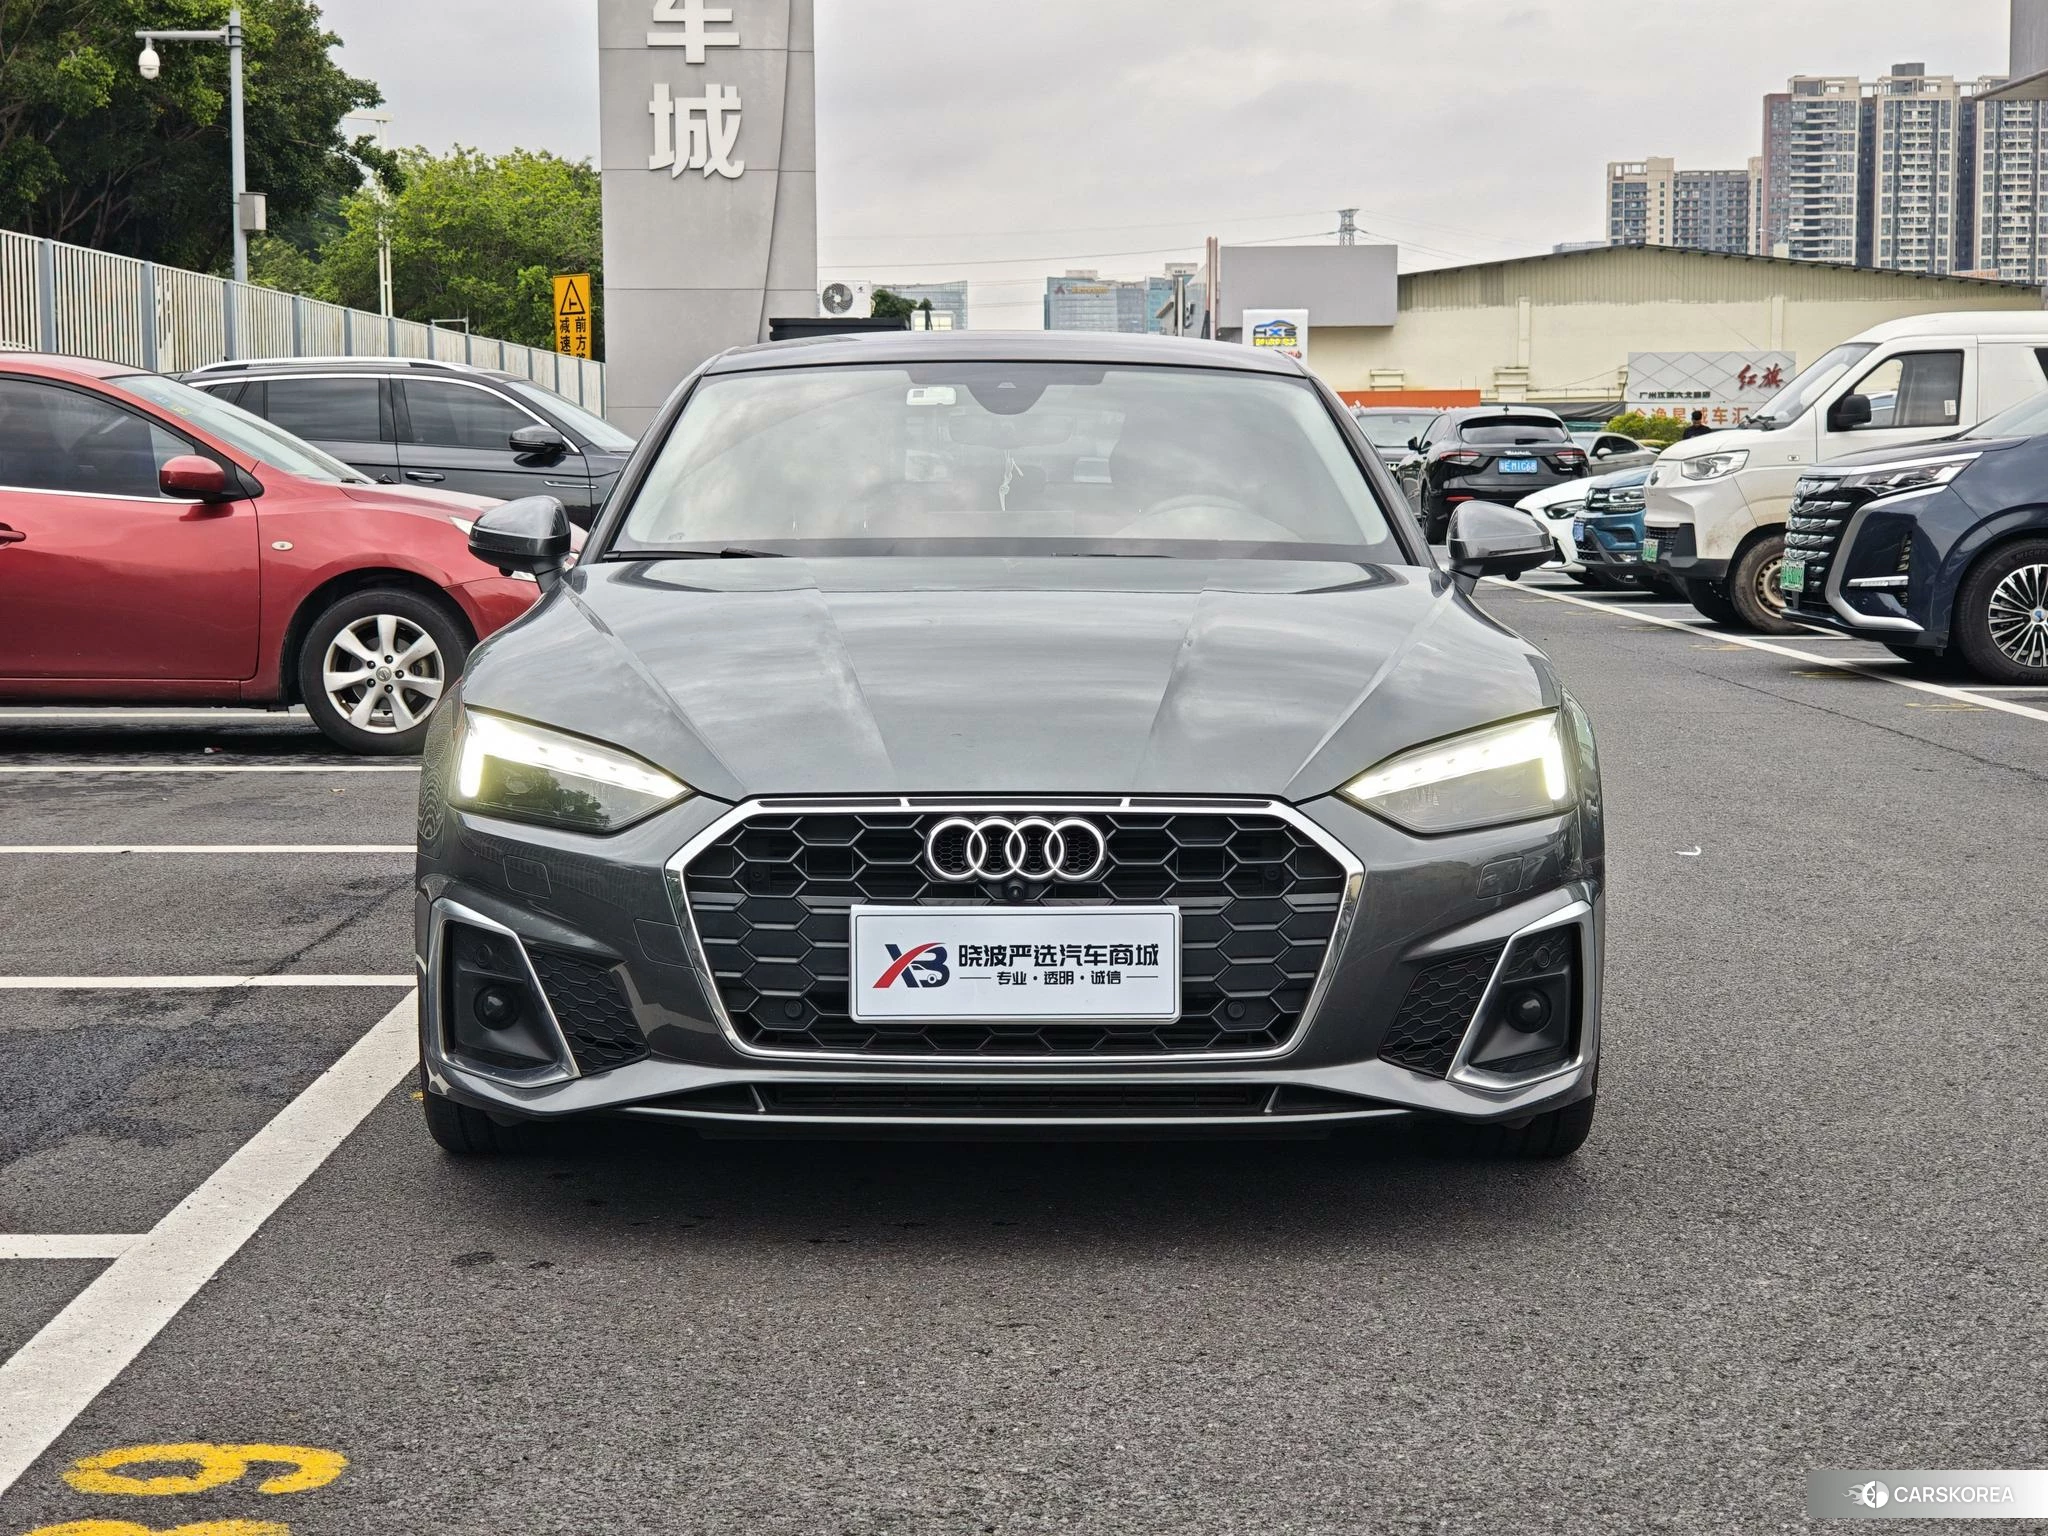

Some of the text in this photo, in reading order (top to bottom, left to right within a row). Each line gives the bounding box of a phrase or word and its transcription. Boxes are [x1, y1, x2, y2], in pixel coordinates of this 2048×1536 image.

[647, 0, 746, 180] 车城
[559, 317, 571, 356] 减速
[958, 943, 1159, 967] 晓波严选汽车商城
